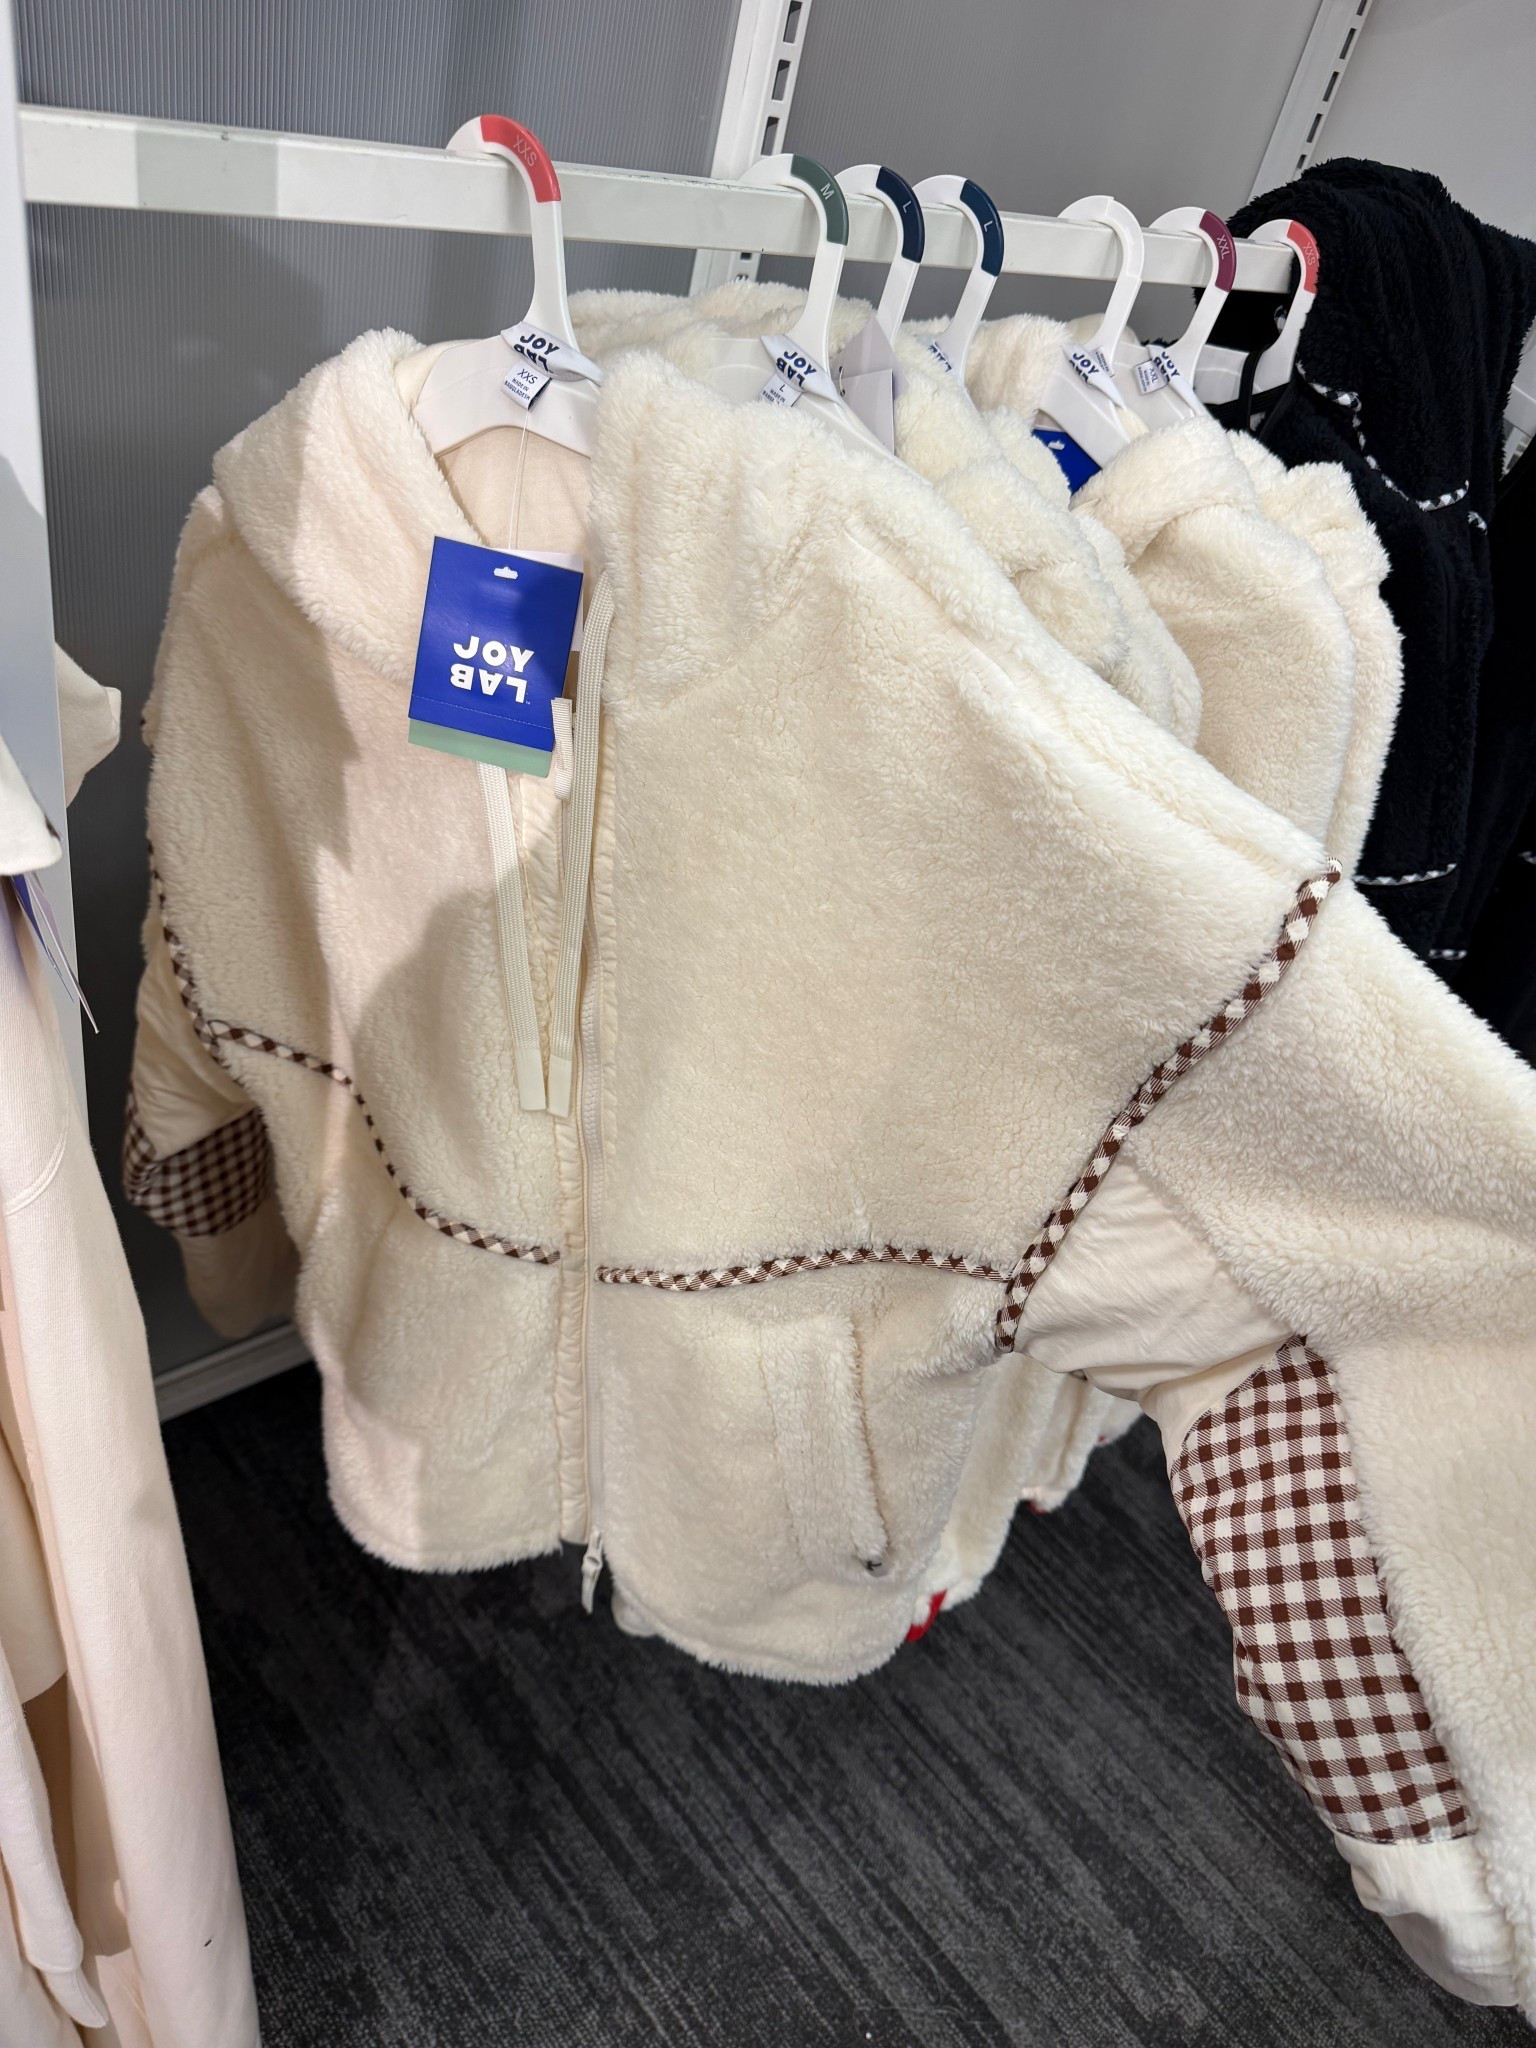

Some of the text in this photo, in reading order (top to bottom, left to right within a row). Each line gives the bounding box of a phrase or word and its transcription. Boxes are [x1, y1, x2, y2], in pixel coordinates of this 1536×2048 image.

[512, 134, 537, 167] XXS
[820, 182, 835, 200] M
[902, 200, 912, 214] L
[983, 220, 993, 232] L
[1216, 234, 1230, 260] XXL
[1303, 242, 1316, 266] XXS
[520, 333, 560, 355] JOY
[776, 357, 805, 387] LAB
[783, 351, 817, 376] JOY
[1072, 352, 1099, 374] JOY
[1161, 351, 1180, 377] JOY
[517, 368, 537, 384] XXS
[504, 380, 531, 401] BANGLADESH
[779, 384, 786, 393] L
[453, 635, 535, 673] JOY
[450, 663, 528, 704] LAB
